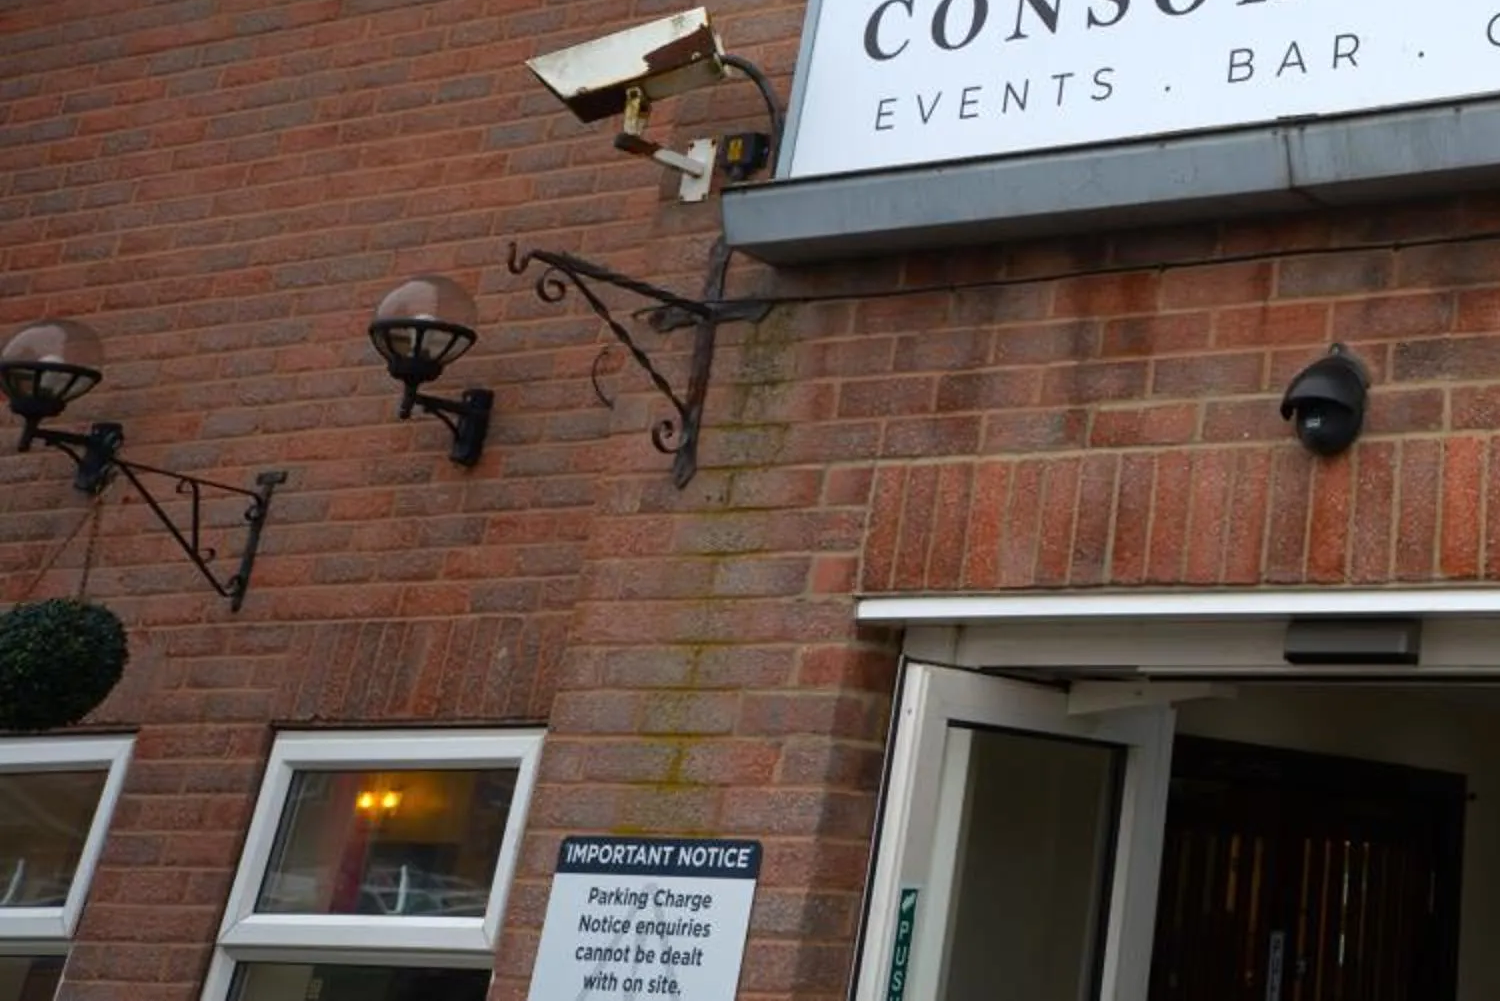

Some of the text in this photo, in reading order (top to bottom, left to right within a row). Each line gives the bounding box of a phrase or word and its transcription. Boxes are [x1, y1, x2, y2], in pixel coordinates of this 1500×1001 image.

[874, 67, 1115, 132] EVENTS
[1226, 33, 1361, 84] BAR
[566, 844, 751, 868] IMPORTANT NOTICE
[587, 886, 713, 911] Parking Charge
[577, 914, 711, 938] Notice enquiries
[574, 944, 703, 967] cannot be dealt
[889, 920, 910, 1001] PUS
[583, 970, 682, 995] with on site.
